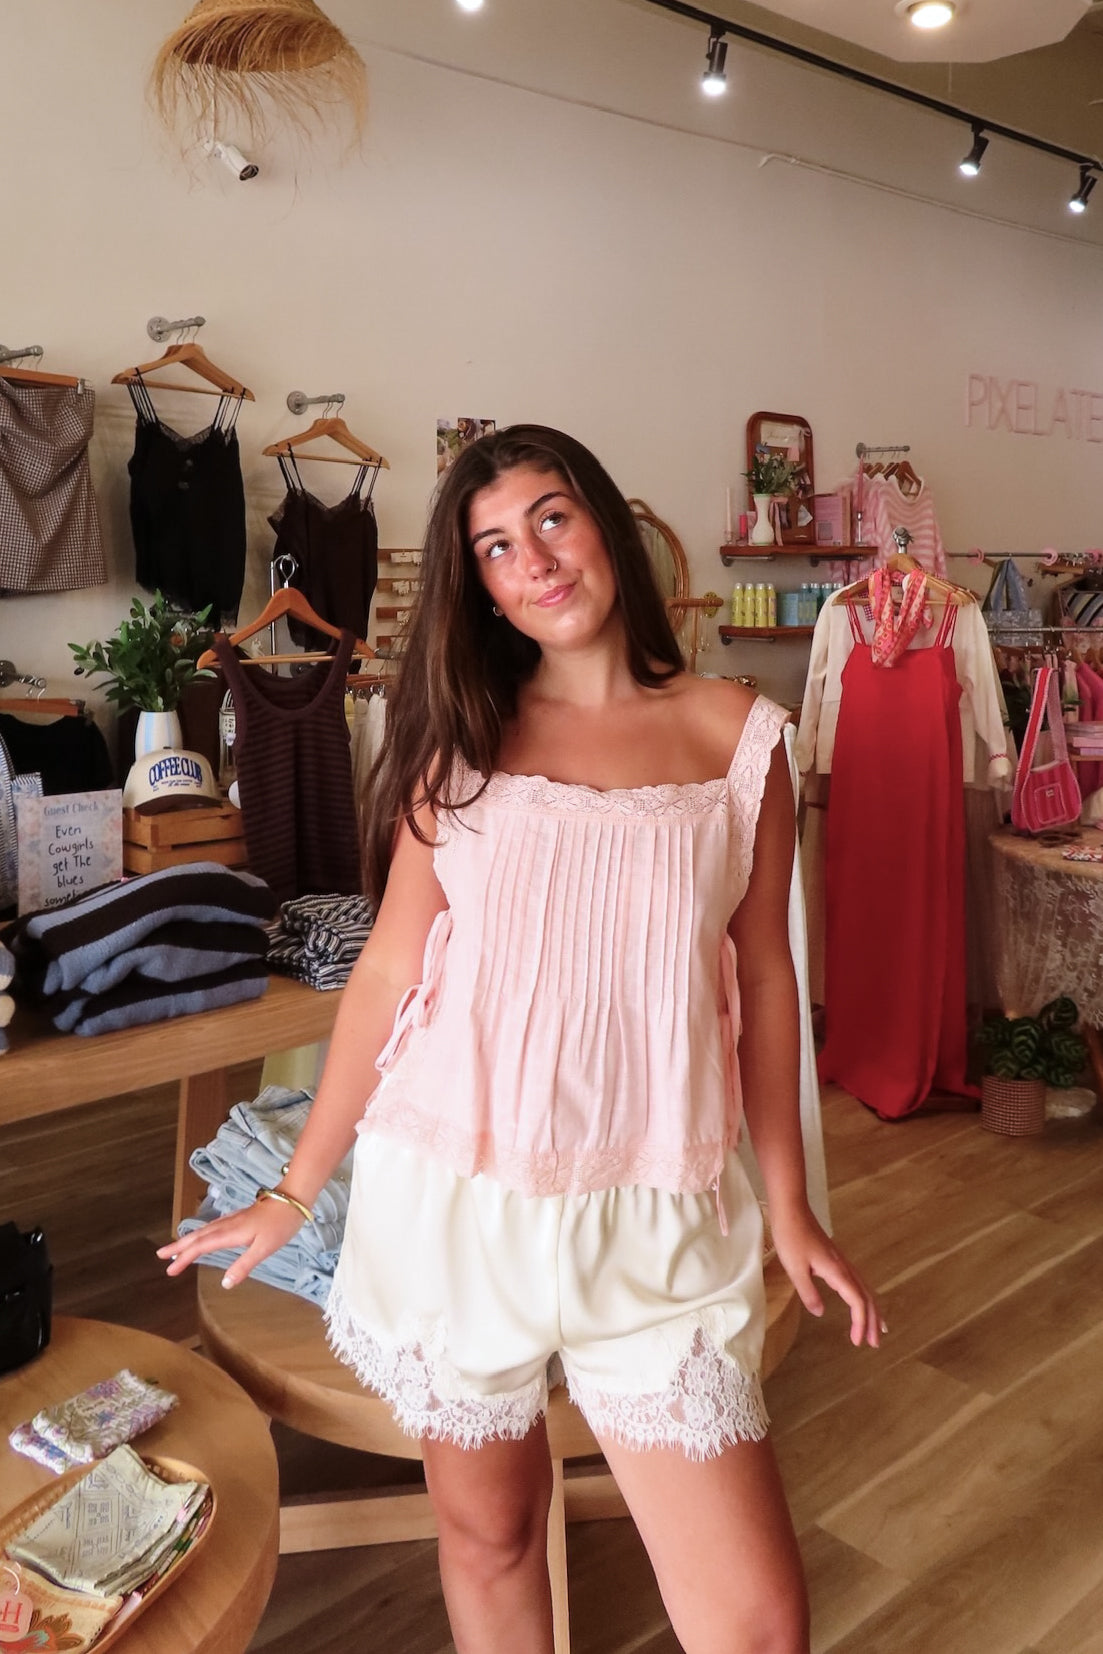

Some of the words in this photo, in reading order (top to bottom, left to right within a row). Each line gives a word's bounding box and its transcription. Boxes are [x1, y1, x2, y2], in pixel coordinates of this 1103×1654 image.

[149, 756, 182, 786] COFFEE
[181, 757, 203, 785] CLUB
[55, 825, 81, 839] Even
[48, 837, 94, 856] Cowgirls
[52, 857, 68, 876] get
[57, 875, 84, 888] blues
[44, 890, 76, 907] somet
